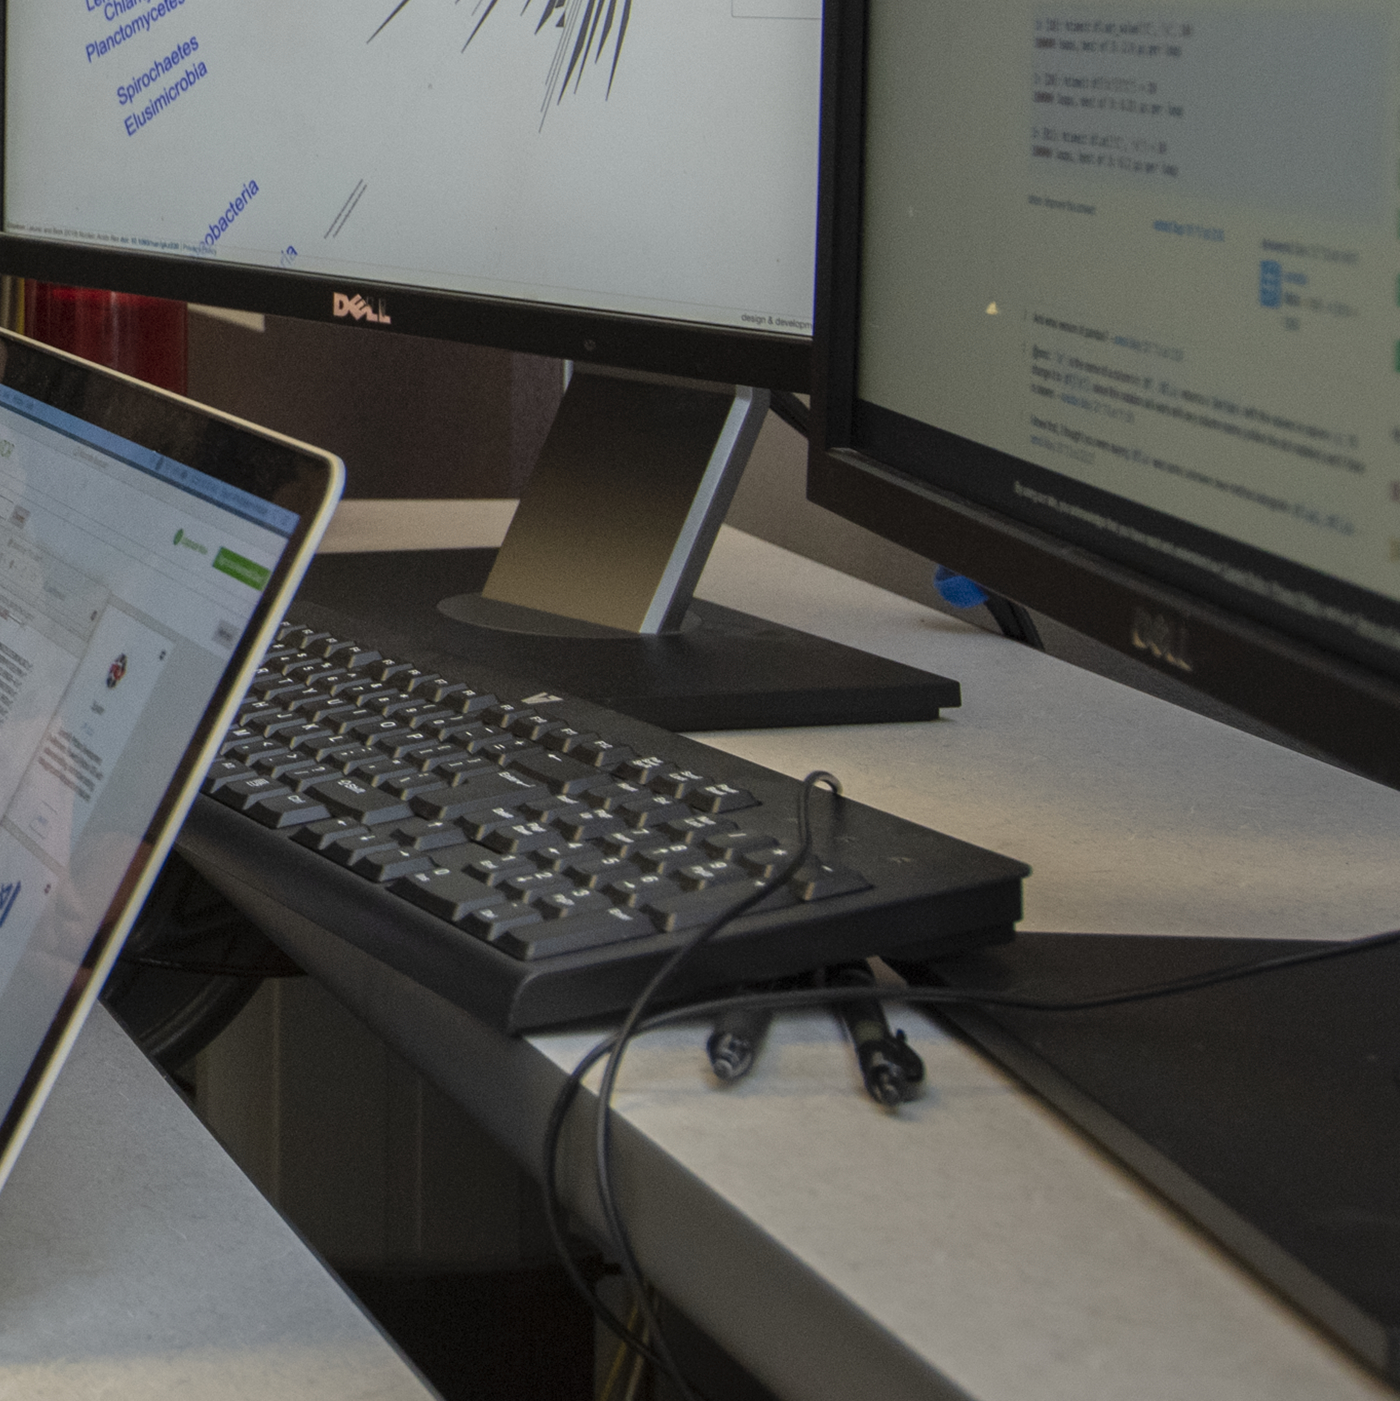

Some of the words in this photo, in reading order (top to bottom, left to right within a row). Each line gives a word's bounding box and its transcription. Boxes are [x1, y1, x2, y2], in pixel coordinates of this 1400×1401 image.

[116, 35, 200, 105] Spirochaetes
[123, 60, 208, 137] Elusimicrobia
[333, 292, 391, 324] DELL
[741, 313, 766, 325] design
[767, 315, 774, 325] &
